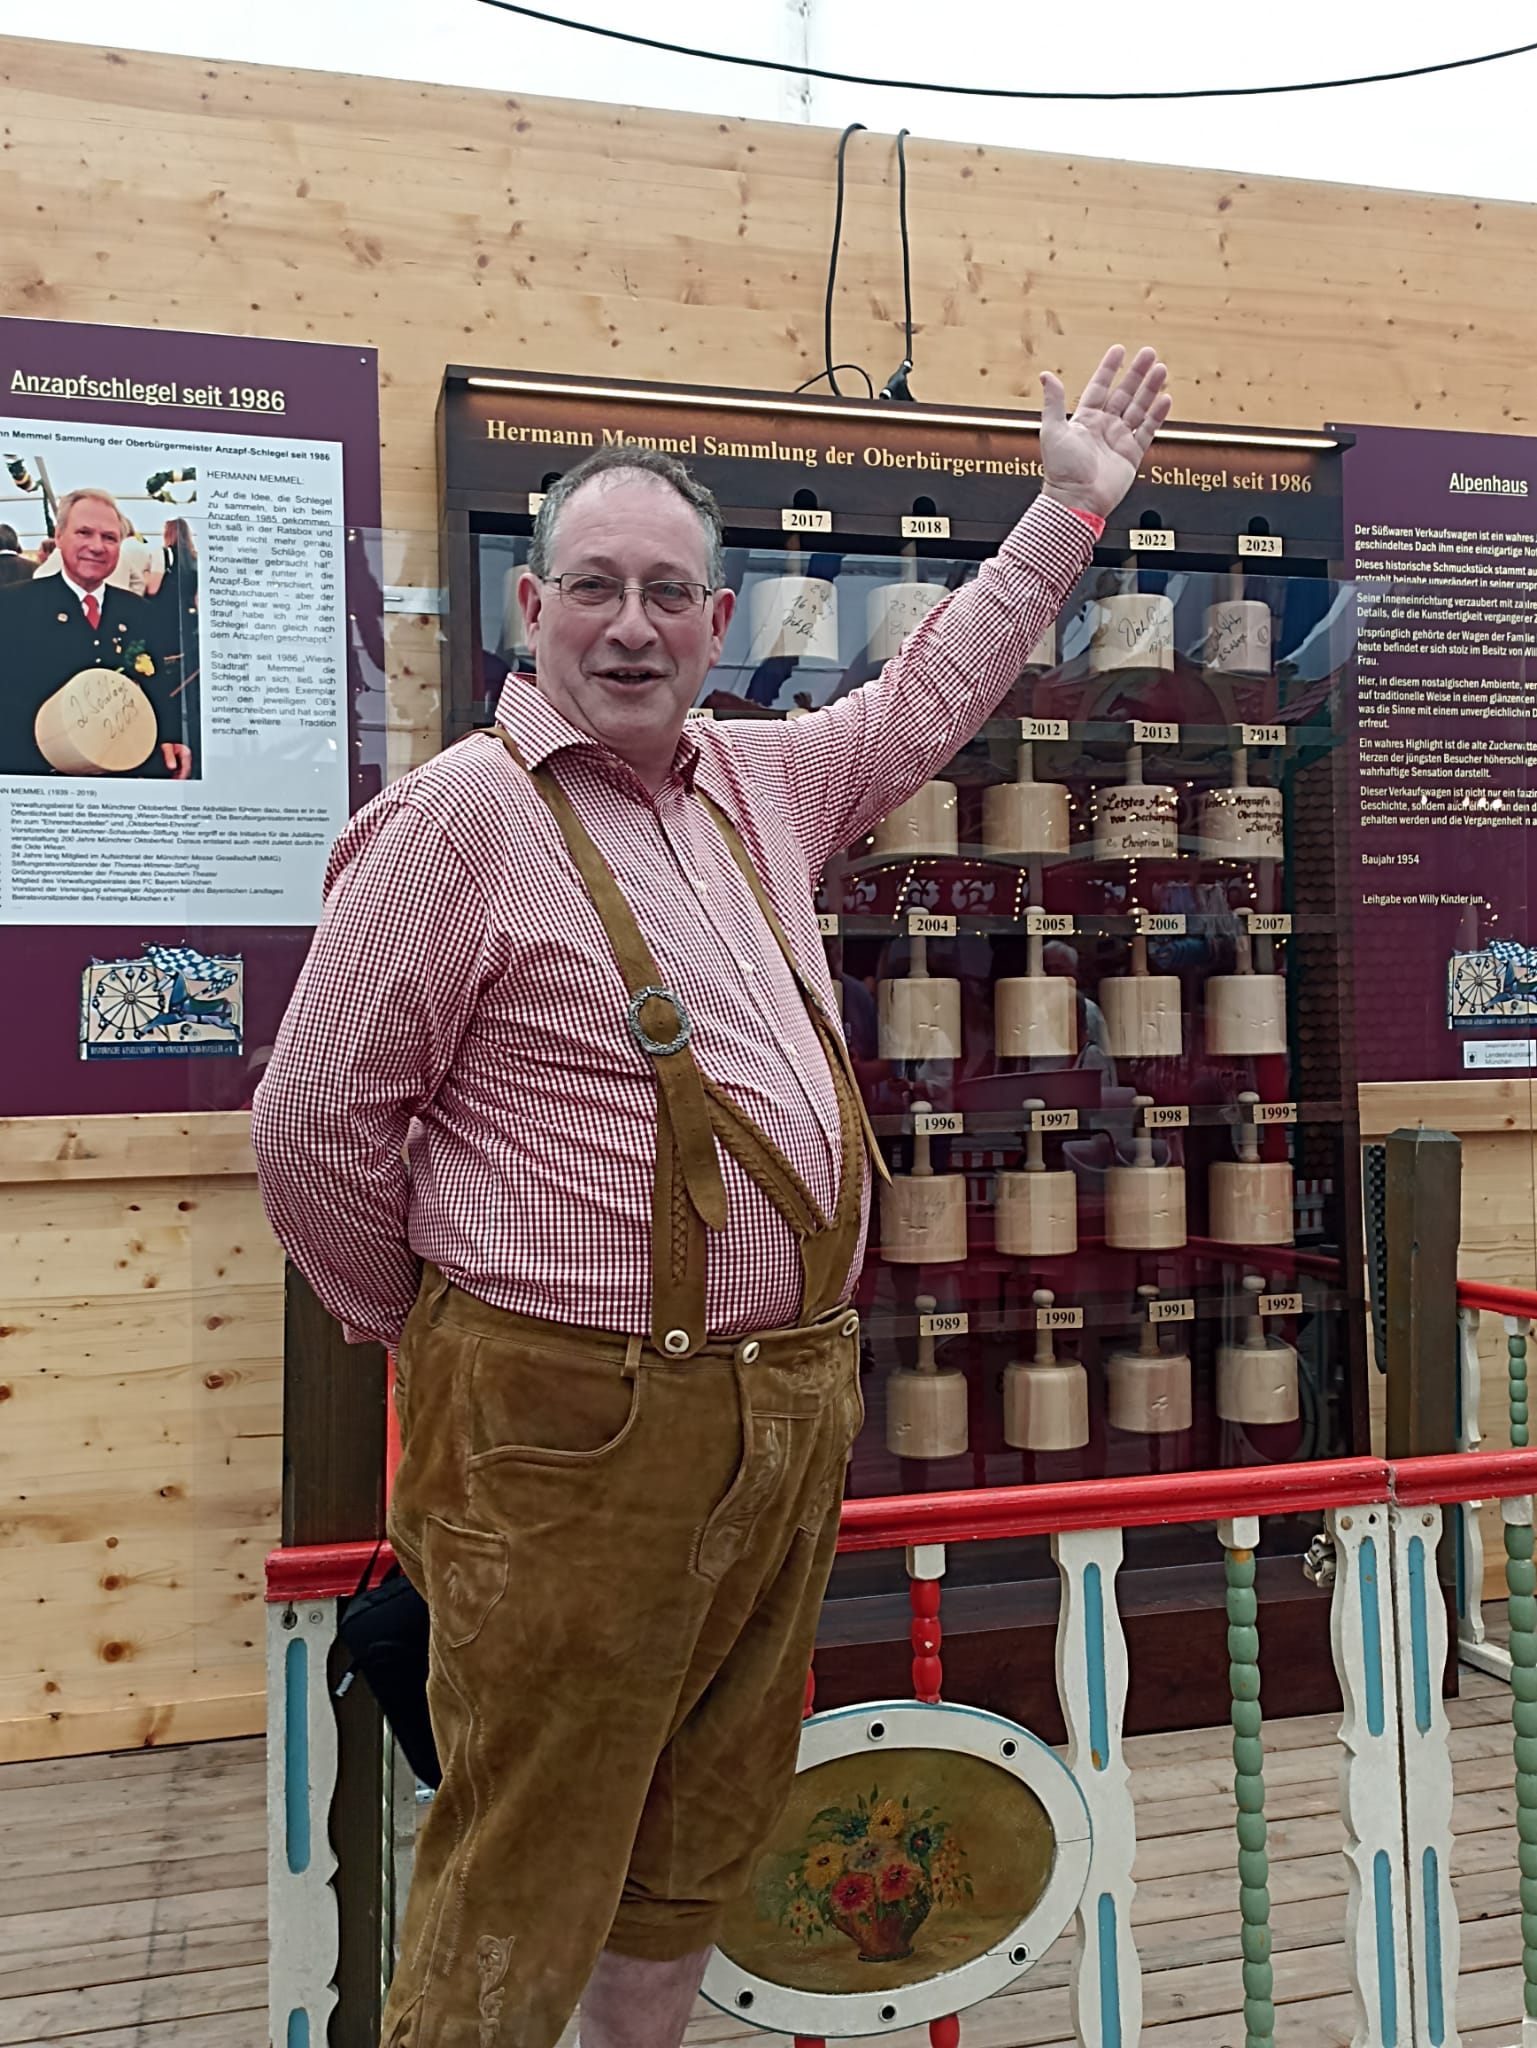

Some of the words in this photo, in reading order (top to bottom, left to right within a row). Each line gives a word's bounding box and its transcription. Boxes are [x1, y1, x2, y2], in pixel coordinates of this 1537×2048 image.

[11, 370, 177, 405] Anzapfschlegel
[183, 386, 222, 407] seit
[229, 388, 285, 412] 1986
[13, 431, 52, 442] Memmel
[55, 434, 105, 448] Sammlung
[108, 437, 123, 447] der
[126, 439, 213, 455] Oberbürgermeister
[216, 445, 289, 460] Anzapf-Schlegel
[291, 450, 307, 460] seit
[310, 451, 330, 461] 1986
[487, 419, 593, 447] Hermann
[602, 428, 697, 454] Memmel
[703, 440, 818, 468] Sammlung
[825, 446, 855, 465] der
[863, 447, 1045, 477] Oberbürgermeiste
[1151, 465, 1227, 491] Schlegel
[1232, 472, 1264, 490] seit
[1270, 473, 1311, 493] 1986
[1449, 472, 1529, 495] Alpenhaus
[792, 514, 822, 526] 2017
[910, 520, 942, 534] 2018
[1138, 534, 1166, 546] 2022
[1355, 525, 1371, 536] Der
[1372, 526, 1413, 538] Süßwaren
[1415, 528, 1478, 543] Verkaufswagen
[1479, 531, 1490, 541] ist
[1491, 532, 1504, 542] ein
[1505, 532, 1535, 543] wahres
[1246, 540, 1274, 552] 2023
[1355, 540, 1414, 554] geschindeltes
[1415, 542, 1437, 553] Dach
[1439, 543, 1454, 554] ihm
[1456, 544, 1474, 555] eine
[1475, 545, 1523, 559] einzigartige
[1356, 559, 1384, 570] Dieses
[1386, 561, 1431, 572] historische
[1433, 562, 1493, 575] Schmuckstück
[1495, 565, 1526, 576] stammt
[1357, 593, 1381, 604] Seine
[1382, 594, 1453, 609] Inneneinrichtung
[1455, 597, 1498, 608] verzaubert
[1500, 598, 1513, 609] mit
[1392, 608, 1405, 619] die
[1407, 609, 1420, 619] die
[1422, 609, 1483, 624] Kunstfertigkeit
[1357, 628, 1411, 642] Ursprünglich
[1413, 630, 1445, 643] gehörte
[1447, 631, 1461, 641] der
[1462, 631, 1490, 644] Wagen
[1492, 632, 1505, 642] der
[1507, 632, 1535, 643] Familie
[1358, 642, 1382, 652] heute
[1384, 643, 1419, 654] befindet
[1420, 646, 1429, 654] er
[1431, 644, 1448, 654] sich
[1449, 645, 1469, 655] stolz
[1470, 645, 1481, 655] im
[1483, 645, 1507, 656] Besitz
[1509, 648, 1523, 656] von
[1380, 677, 1388, 687] in
[1390, 677, 1420, 688] diesem
[1422, 678, 1479, 691] nostalgischen
[1359, 690, 1373, 700] auf
[1374, 690, 1425, 701] traditionelle
[1426, 691, 1452, 702] Weise
[1453, 692, 1461, 702] in
[1463, 692, 1488, 703] einem
[1030, 722, 1060, 736] 2012
[1142, 726, 1172, 738] 2013
[1250, 728, 1278, 740] 2014
[1360, 738, 1373, 748] Ein
[1375, 738, 1404, 749] wahres
[1406, 739, 1444, 752] Highlight
[1445, 740, 1456, 750] ist
[1457, 740, 1470, 750] die
[1472, 740, 1488, 750] alte
[1360, 753, 1389, 763] Herzen
[1391, 753, 1405, 763] der
[1406, 753, 1442, 766] jüngsten
[1444, 754, 1483, 764] Besucher
[1360, 766, 1410, 779] wahrhaftige
[1412, 767, 1453, 778] Sensation
[1361, 814, 1398, 827] gehalten
[1400, 815, 1430, 825] werden
[1432, 815, 1448, 825] und
[1449, 815, 1463, 825] die
[1464, 815, 1523, 828] Vergangenheit
[1362, 855, 1395, 867] Baujahr
[1398, 855, 1420, 865] 1954
[1363, 894, 1401, 906] Leihgabe
[1419, 894, 1439, 906] Willy
[1441, 894, 1469, 904] Kinzler
[916, 918, 948, 932] 2004
[1036, 918, 1066, 930] 2005
[1148, 918, 1178, 930] 2006
[1256, 918, 1284, 930] 2007
[1040, 1114, 1070, 1126] 1997
[1152, 1110, 1182, 1124] 1998
[1262, 1106, 1290, 1120] 1999
[926, 1118, 956, 1130] 1996
[1158, 1304, 1186, 1318] 1991
[1268, 1298, 1296, 1310] 1992
[930, 1318, 960, 1332] 1989
[1046, 1312, 1076, 1324] 1990
